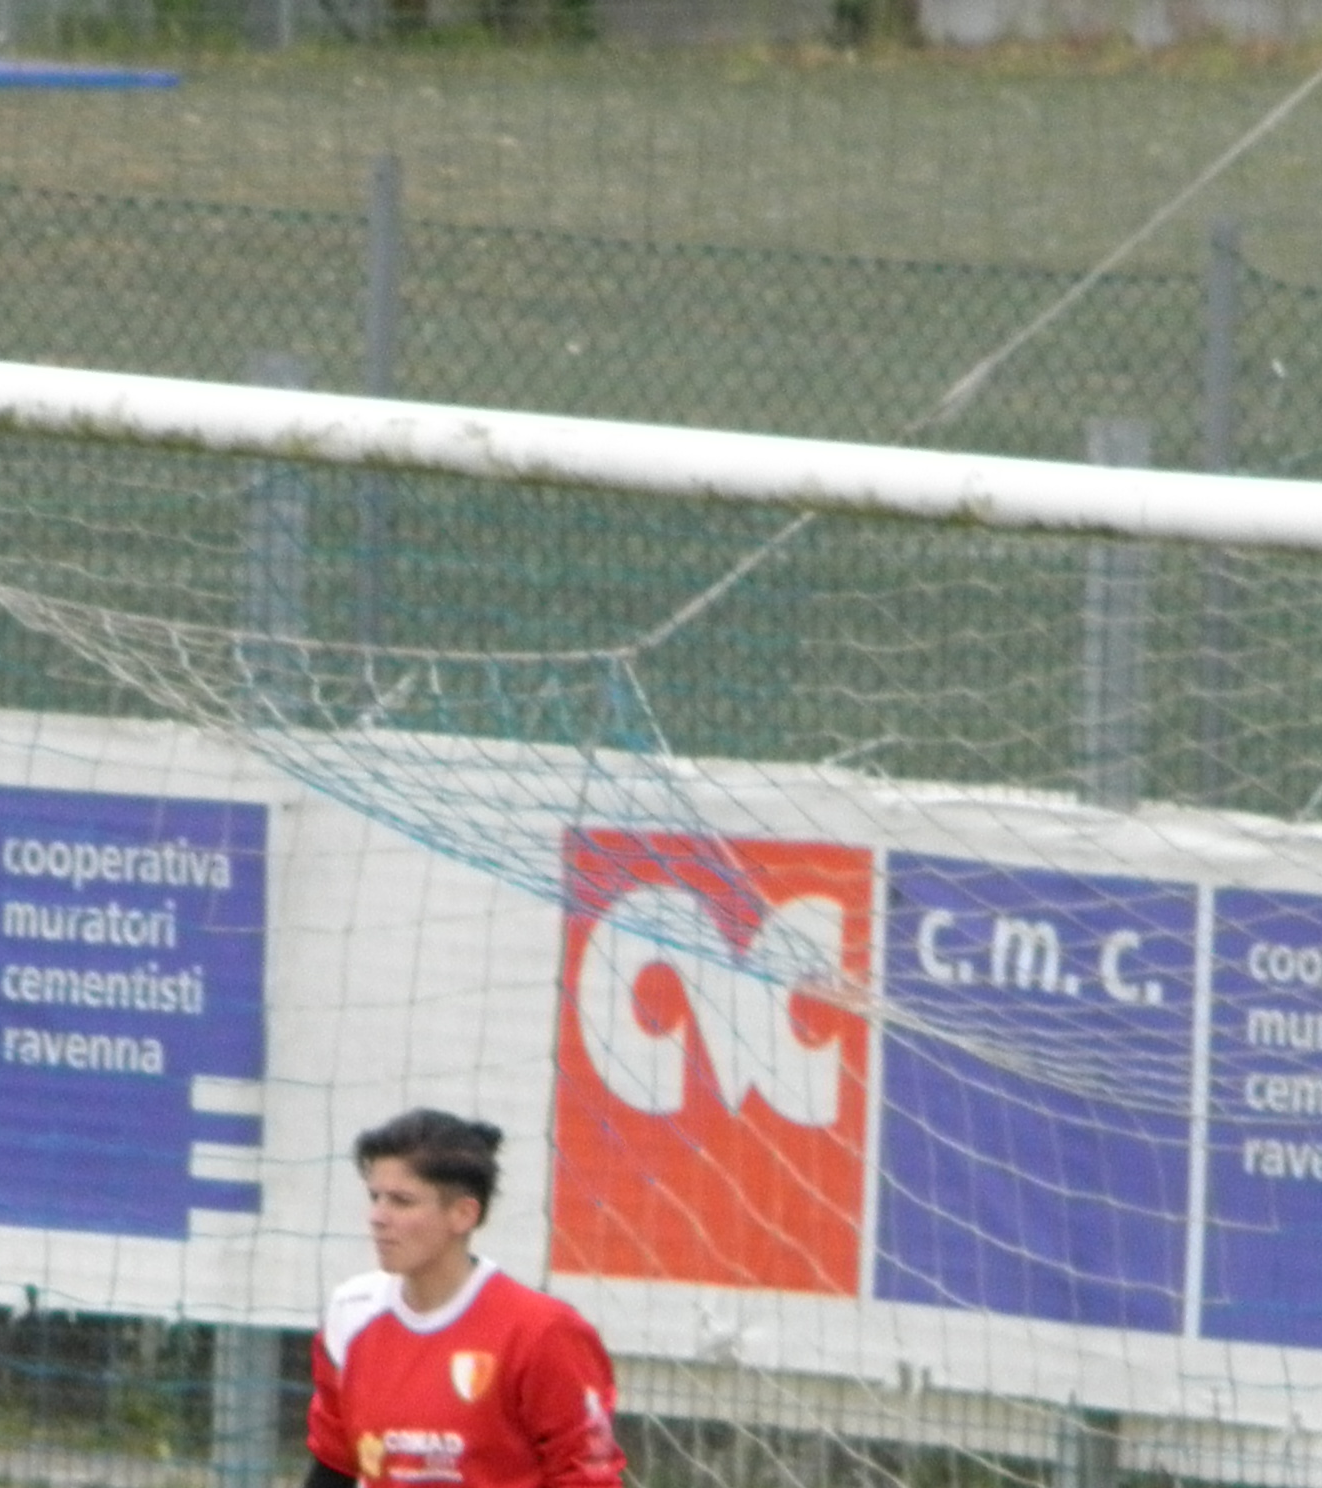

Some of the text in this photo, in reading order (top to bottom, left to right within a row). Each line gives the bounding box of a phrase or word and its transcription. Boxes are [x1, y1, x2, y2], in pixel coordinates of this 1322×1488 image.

[2, 836, 232, 892] cooperativa
[2, 898, 176, 949] muratori
[1, 961, 204, 1016] cementisti
[1, 1026, 164, 1075] ravenna
